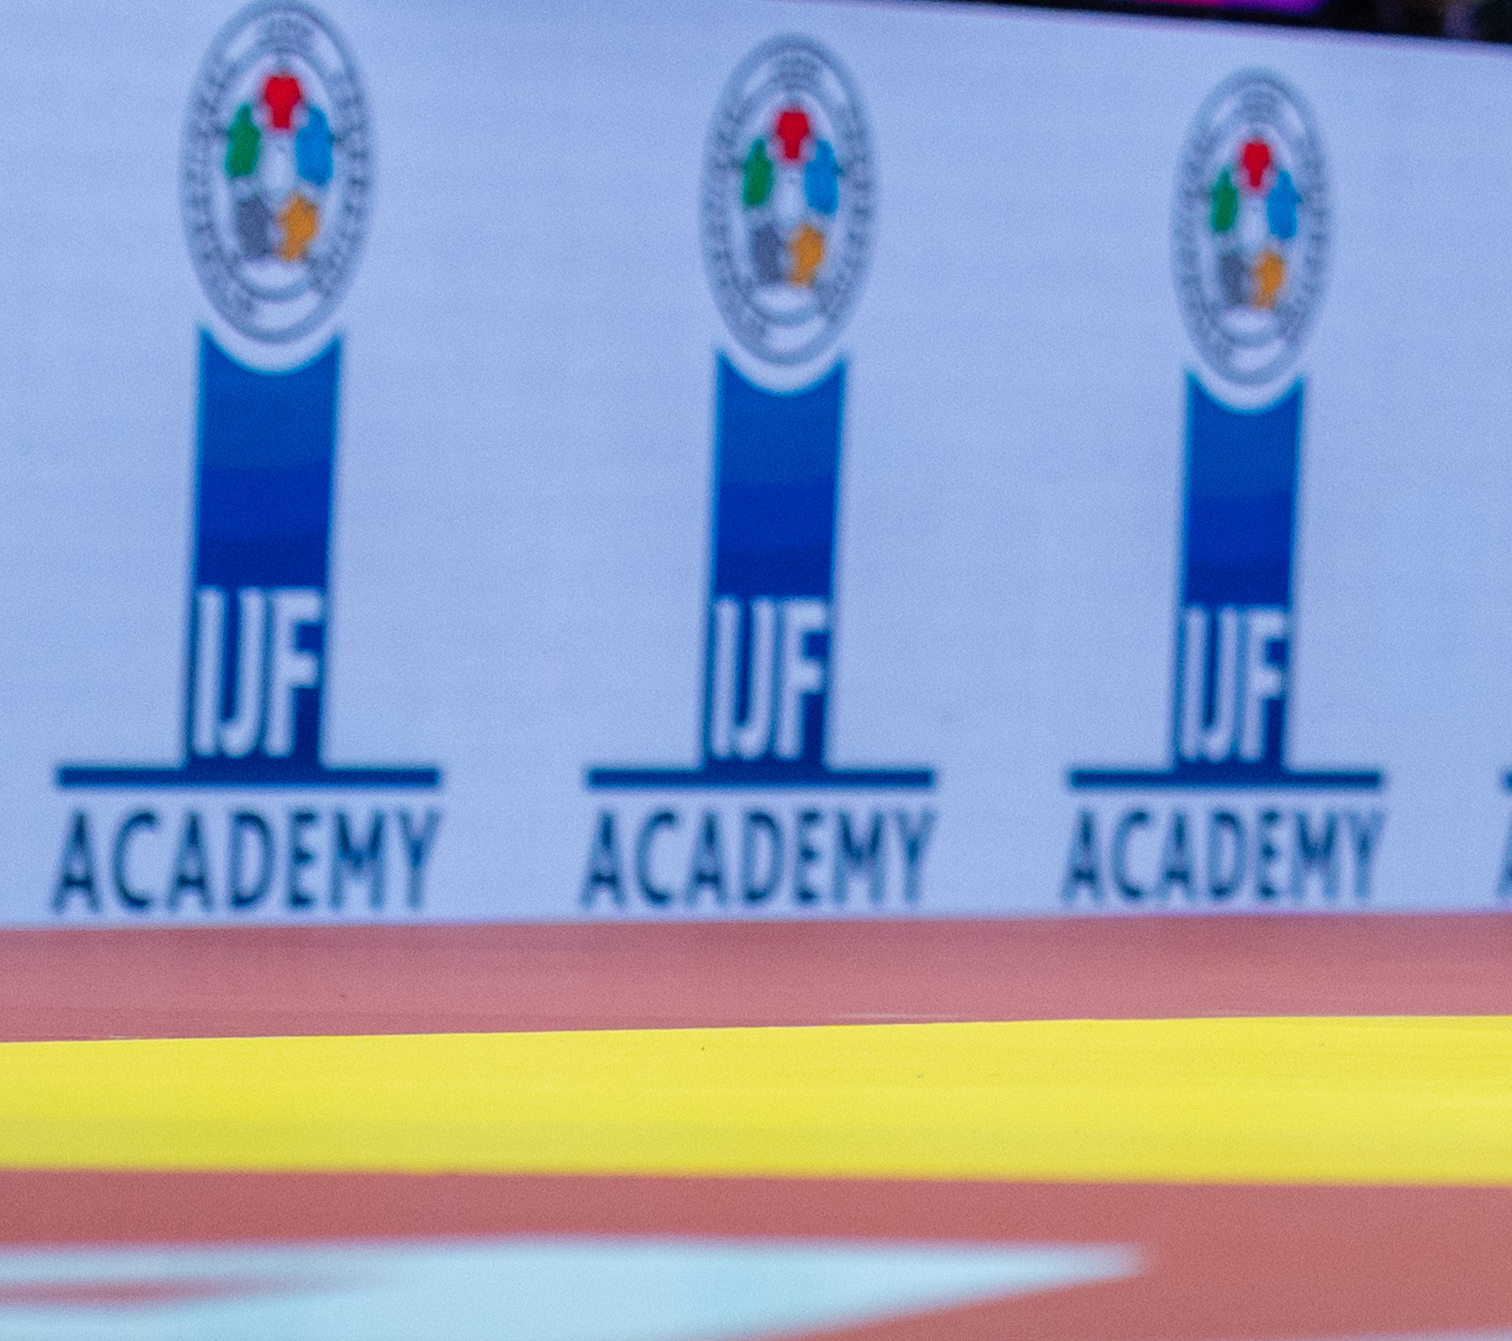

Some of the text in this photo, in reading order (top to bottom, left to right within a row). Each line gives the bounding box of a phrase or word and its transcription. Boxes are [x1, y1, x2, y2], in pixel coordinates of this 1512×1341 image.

[194, 587, 325, 760] IJF
[709, 595, 829, 762] IJF
[1179, 604, 1290, 764] IJF
[50, 805, 443, 917] ACADEMY
[583, 806, 938, 909] ACADEMY
[1060, 805, 1386, 906] ACADEMY
